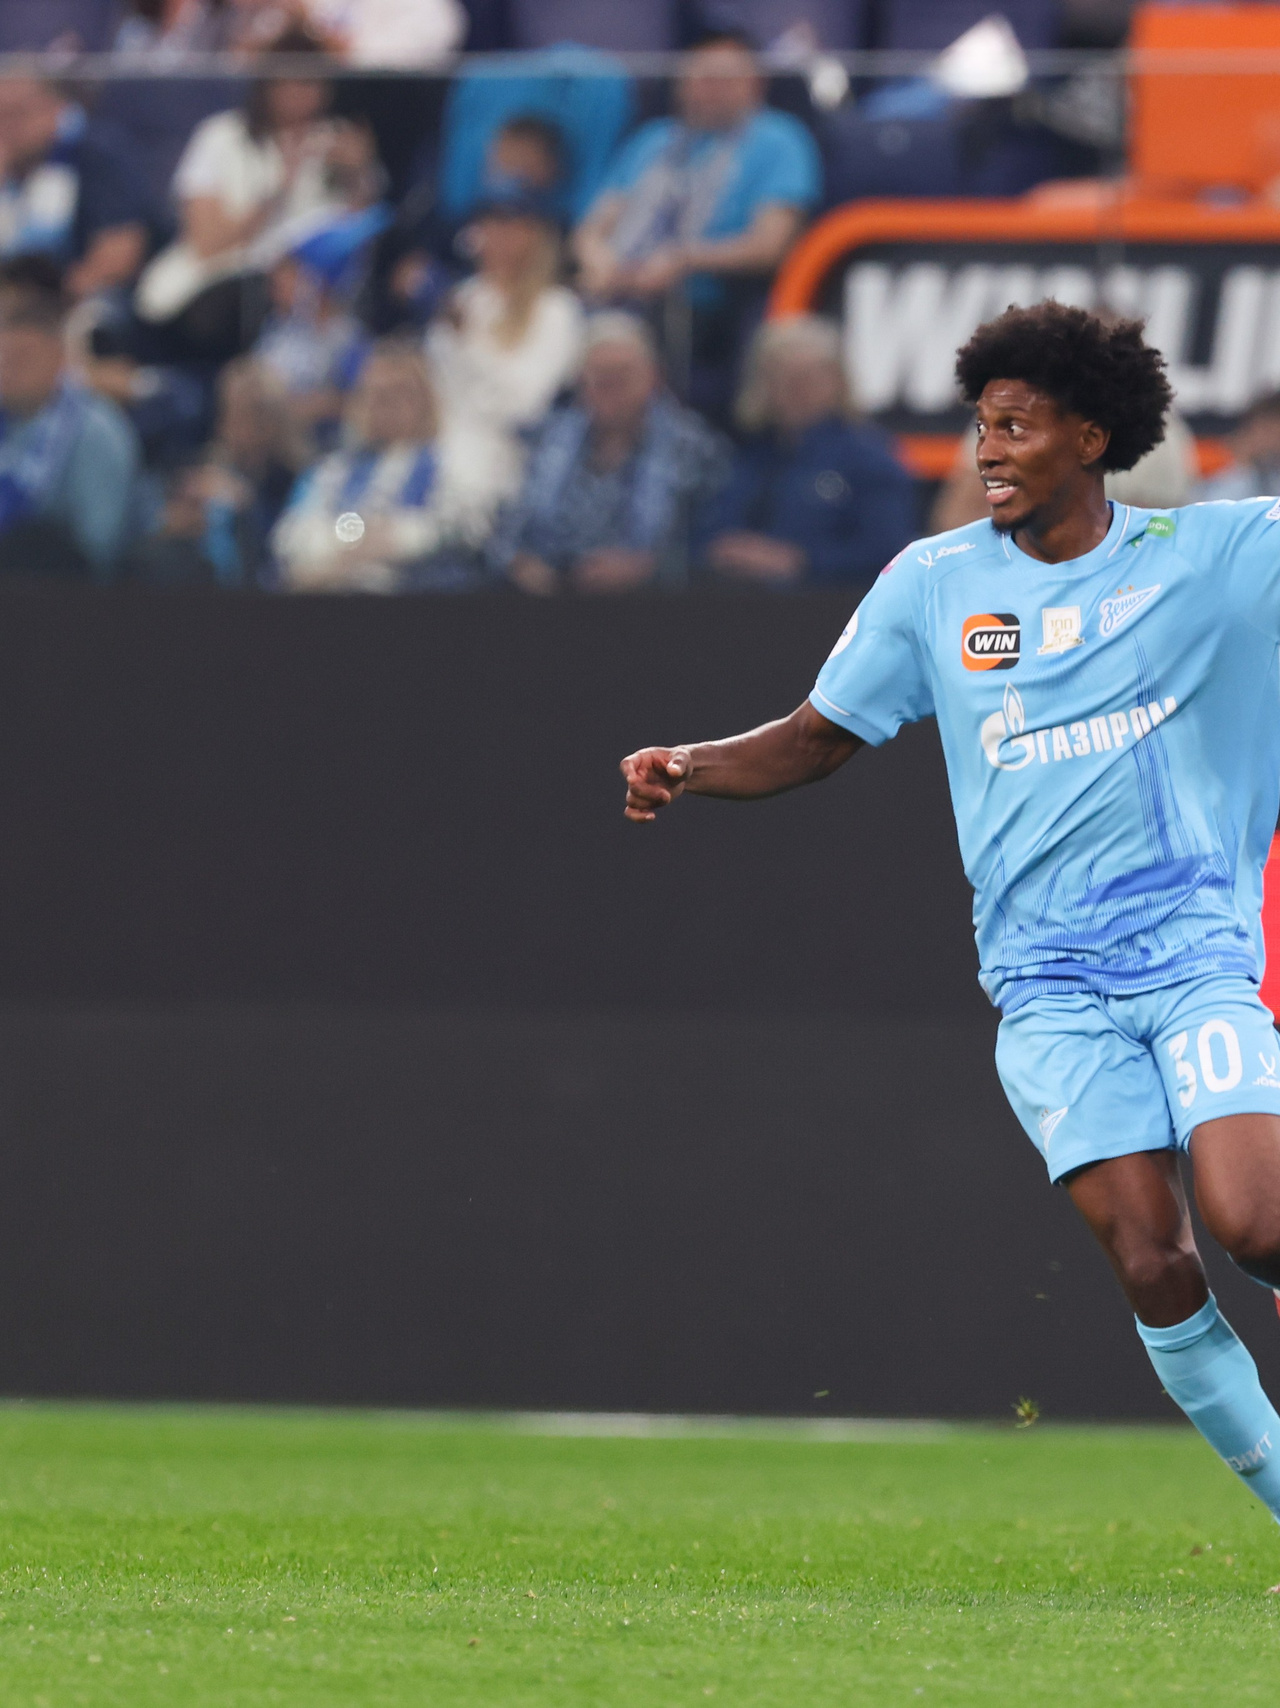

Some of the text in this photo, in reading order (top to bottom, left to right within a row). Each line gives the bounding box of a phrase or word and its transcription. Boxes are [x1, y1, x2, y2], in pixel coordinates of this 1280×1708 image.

[974, 633, 1017, 652] WIN
[1035, 696, 1178, 764] ГАЗПРОМ
[1168, 1018, 1243, 1108] 30
